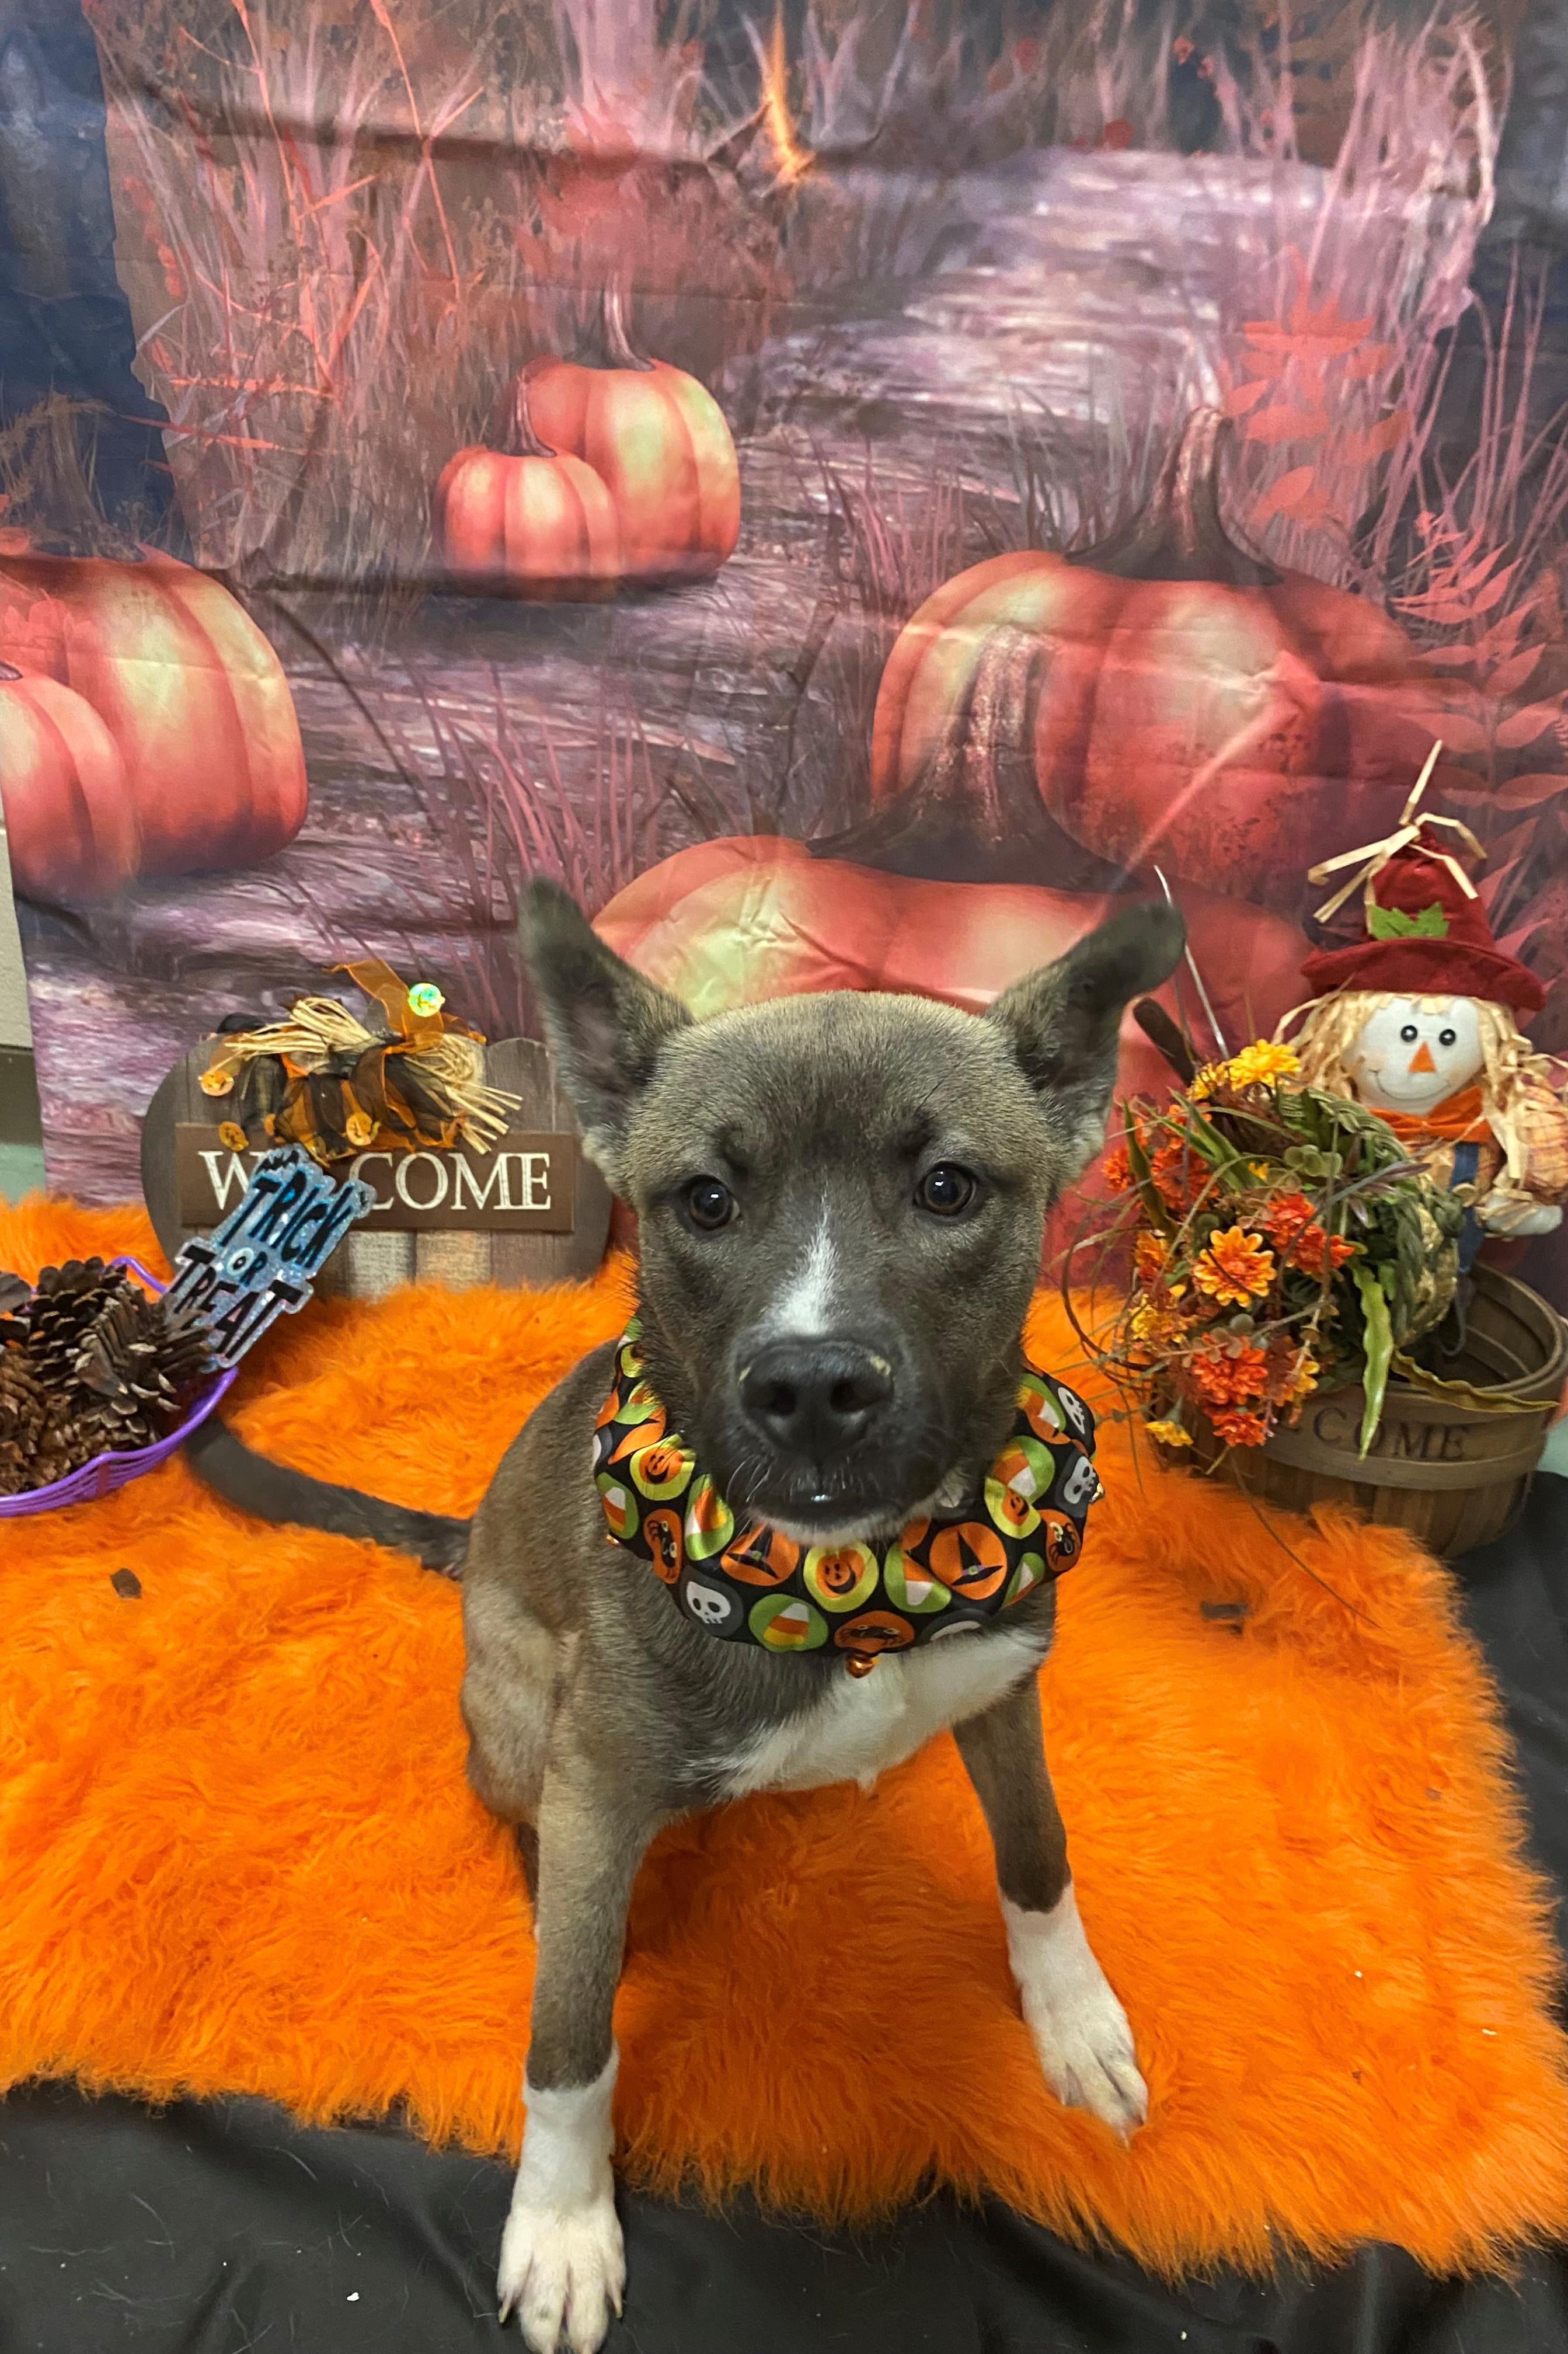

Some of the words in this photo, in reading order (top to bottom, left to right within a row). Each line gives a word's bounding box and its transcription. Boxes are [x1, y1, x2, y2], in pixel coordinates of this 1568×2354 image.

[198, 1151, 551, 1210] WCOME
[220, 1171, 356, 1269] TRICK
[226, 1248, 268, 1287] OR
[170, 1244, 304, 1359] TREAT
[1280, 1406, 1471, 1459] COME
